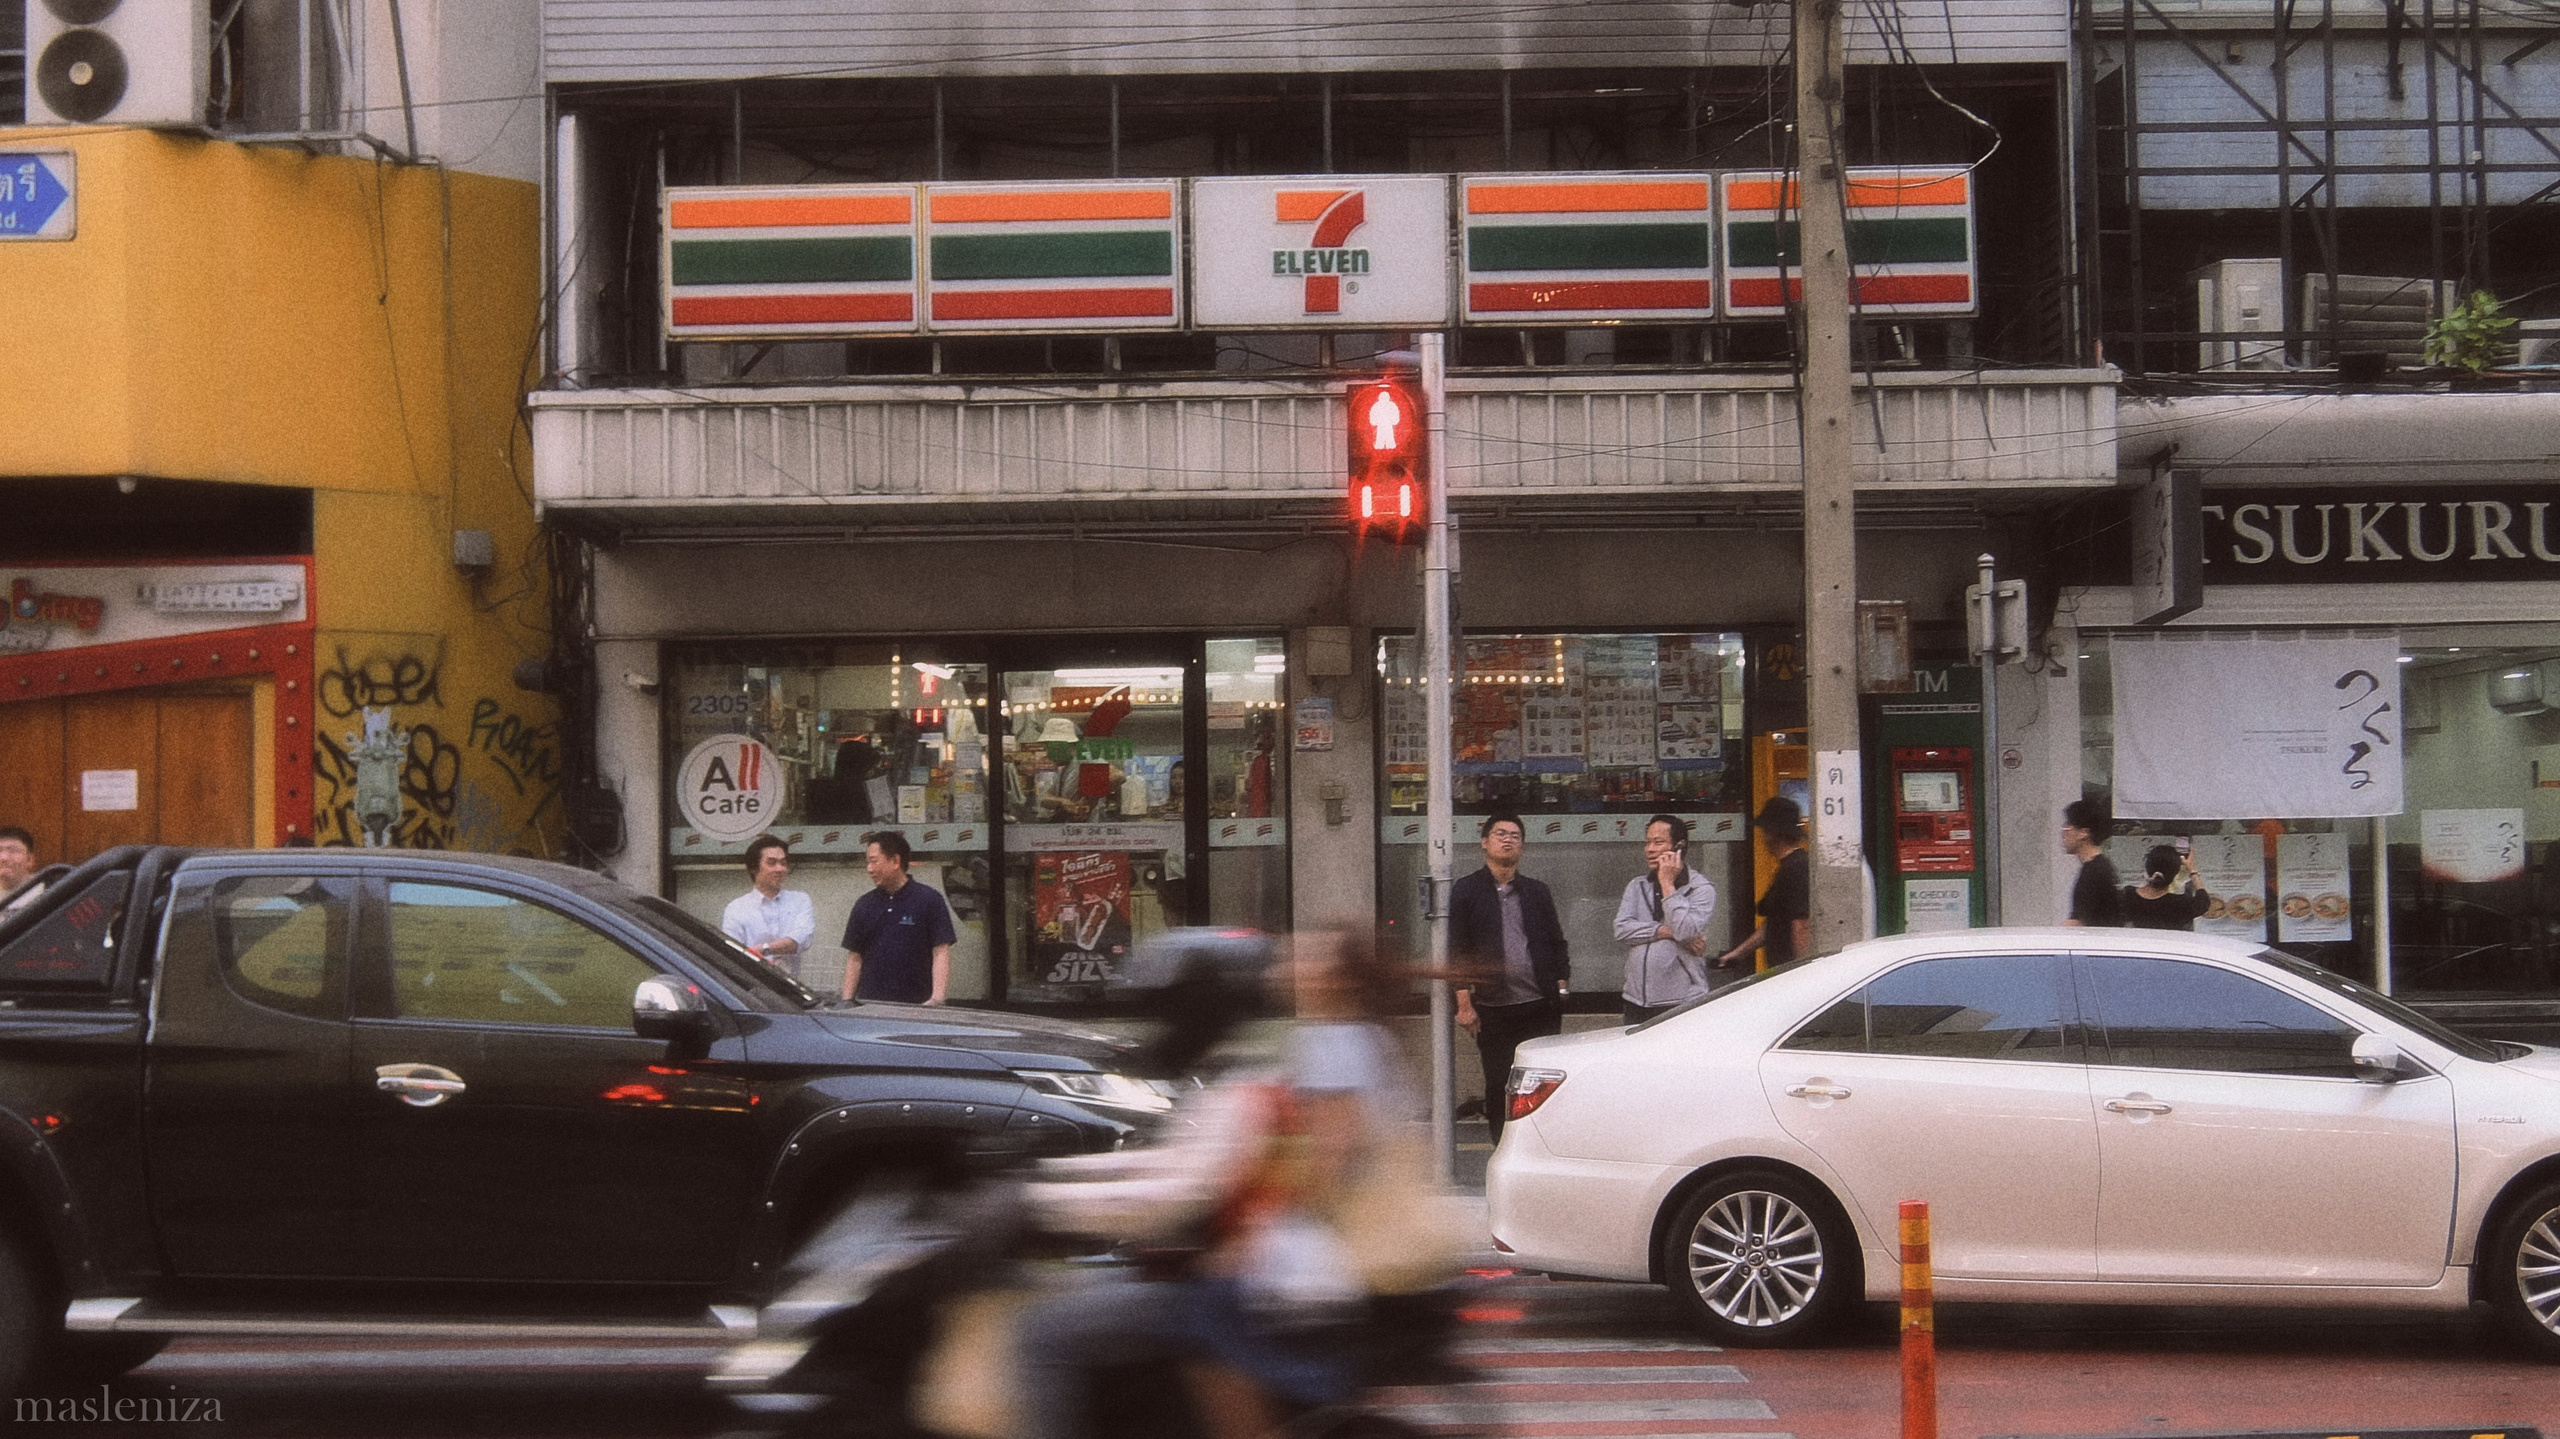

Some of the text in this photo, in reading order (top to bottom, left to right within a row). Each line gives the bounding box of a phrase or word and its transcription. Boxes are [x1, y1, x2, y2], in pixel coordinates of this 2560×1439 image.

[1914, 671, 1948, 692] TM
[690, 695, 748, 714] 2305
[2334, 669, 2391, 790] つくる
[701, 744, 761, 792] All
[701, 792, 760, 815] Café
[1824, 796, 1845, 816] 61
[1047, 961, 1122, 983] SIZE
